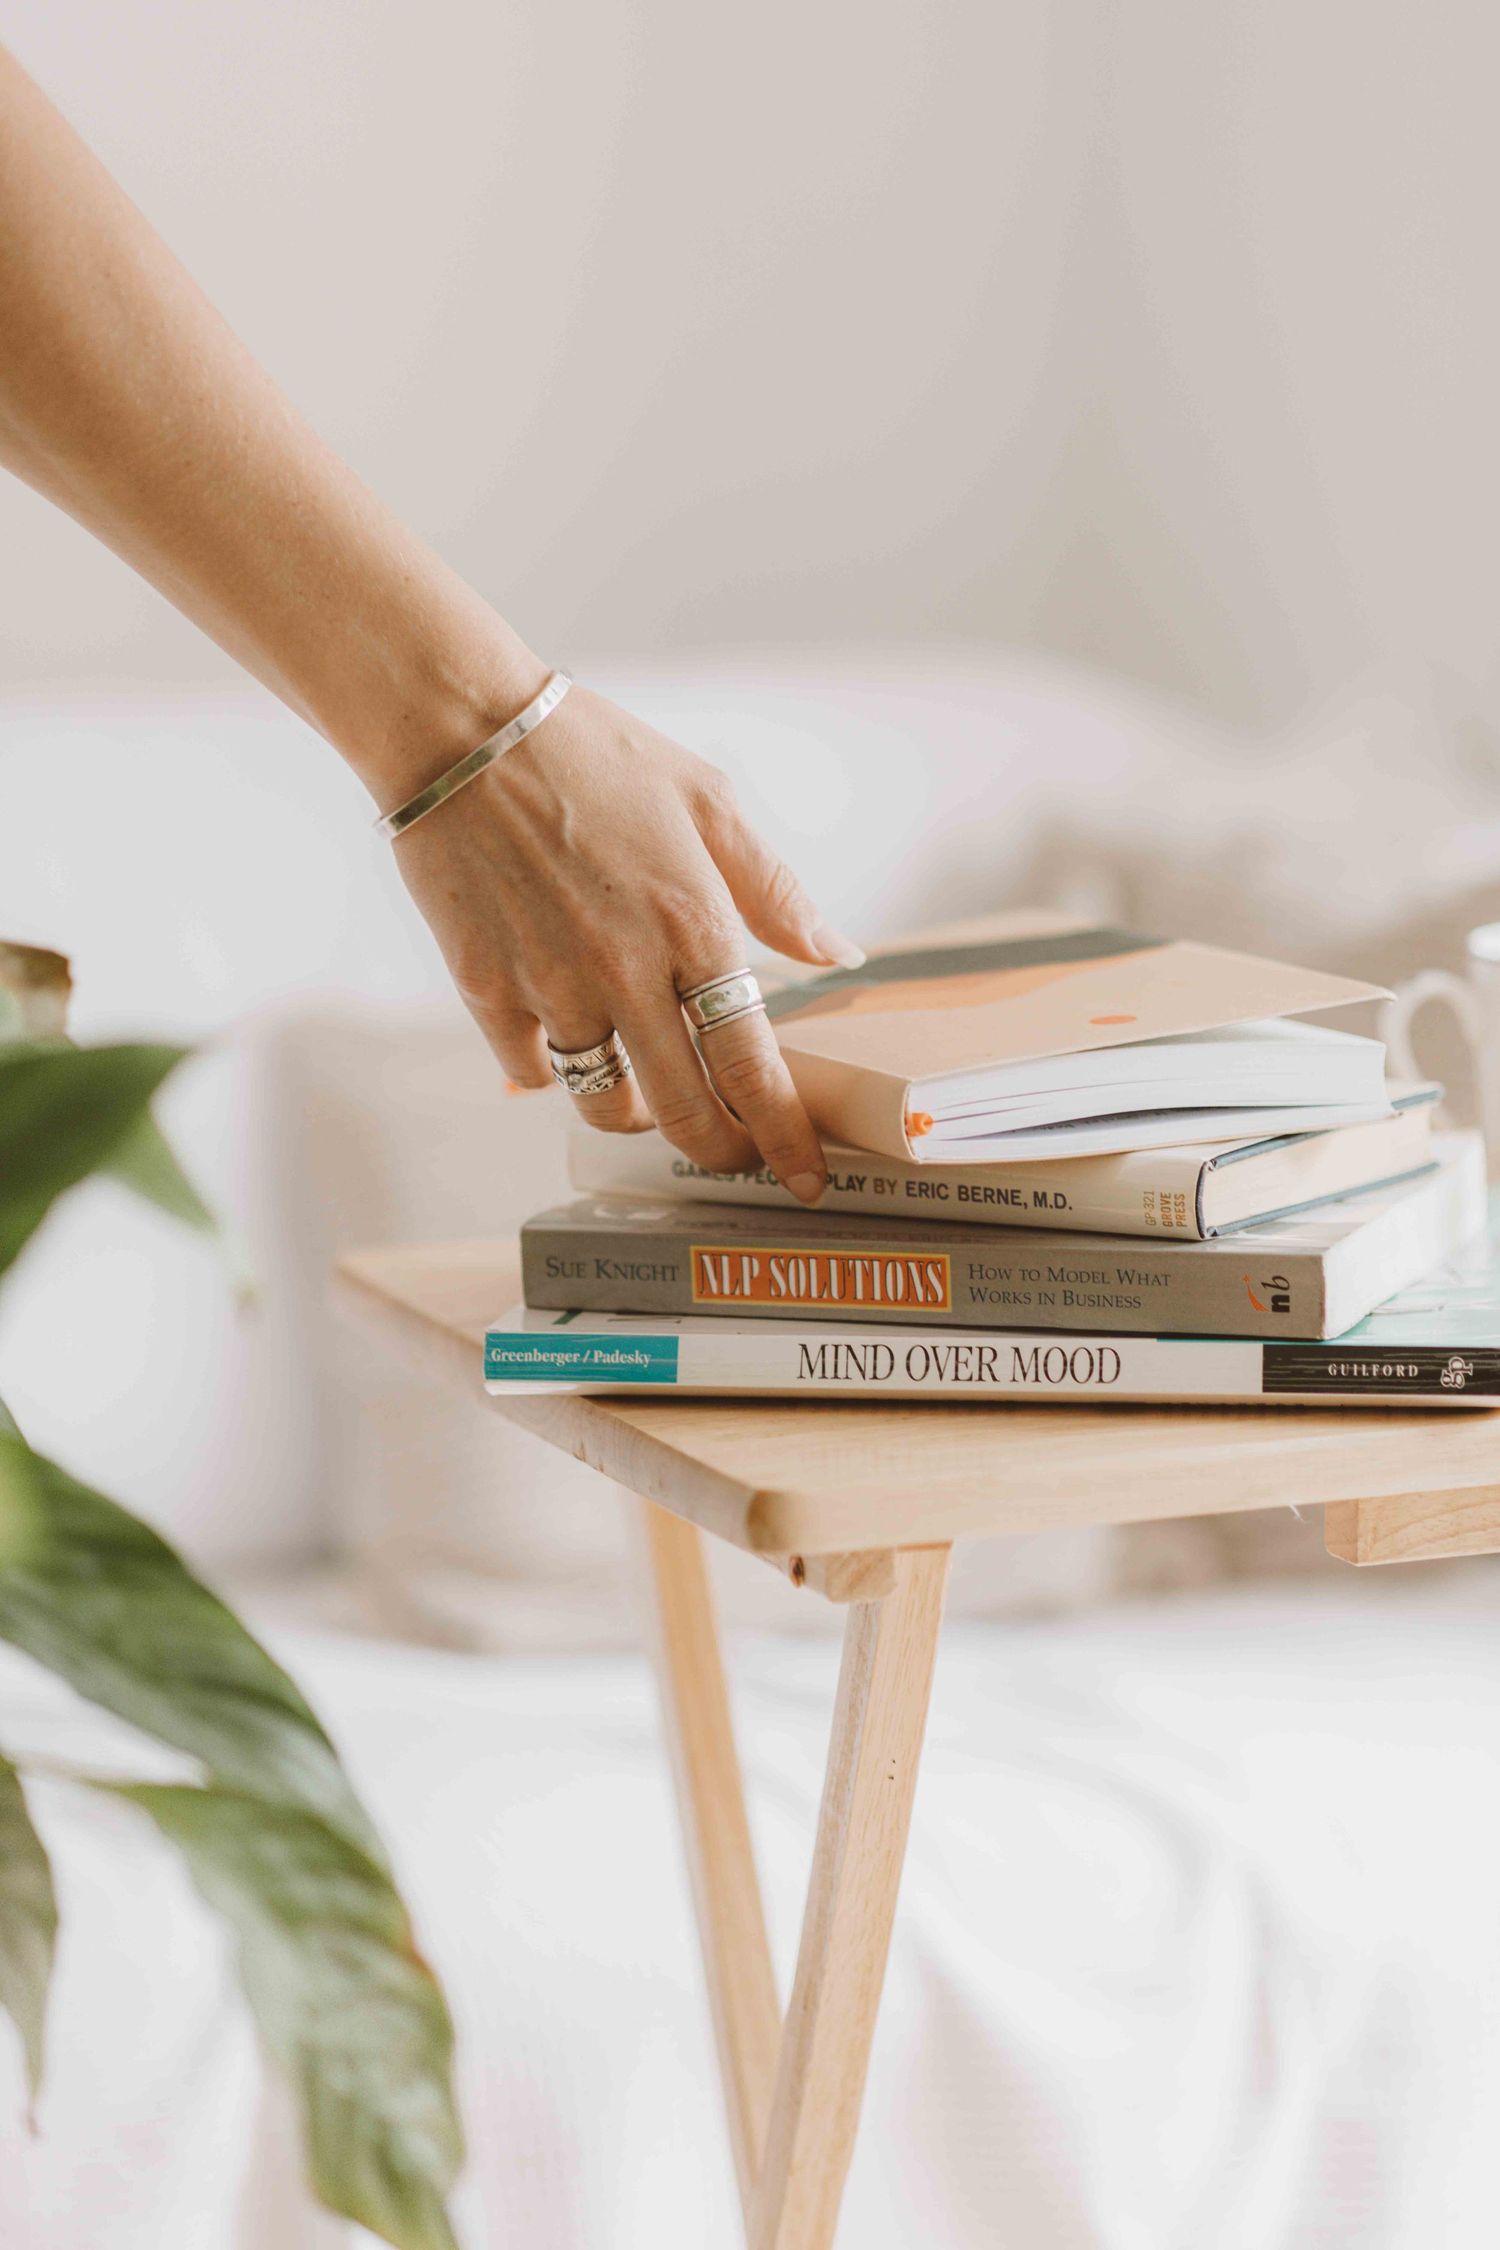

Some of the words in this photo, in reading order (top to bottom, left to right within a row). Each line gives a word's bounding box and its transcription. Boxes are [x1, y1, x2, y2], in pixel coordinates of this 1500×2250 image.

[873, 1177, 898, 1196] BY
[905, 1180, 950, 1200] ERIC
[957, 1184, 1028, 1210] BERNE,
[1033, 1191, 1073, 1211] M.D.
[1143, 1191, 1157, 1226] GP-321
[1160, 1192, 1174, 1227] GROVE
[1174, 1193, 1188, 1227] PRESS
[699, 1253, 760, 1297] NLP
[769, 1255, 944, 1304] SOLUTIONS
[490, 1348, 580, 1366] Greenberger
[594, 1350, 651, 1368] Padesky
[797, 1343, 895, 1381] MIND
[905, 1344, 1000, 1382] OVER
[1009, 1346, 1121, 1384] MOOD
[1327, 1363, 1419, 1377] GUILFORD
